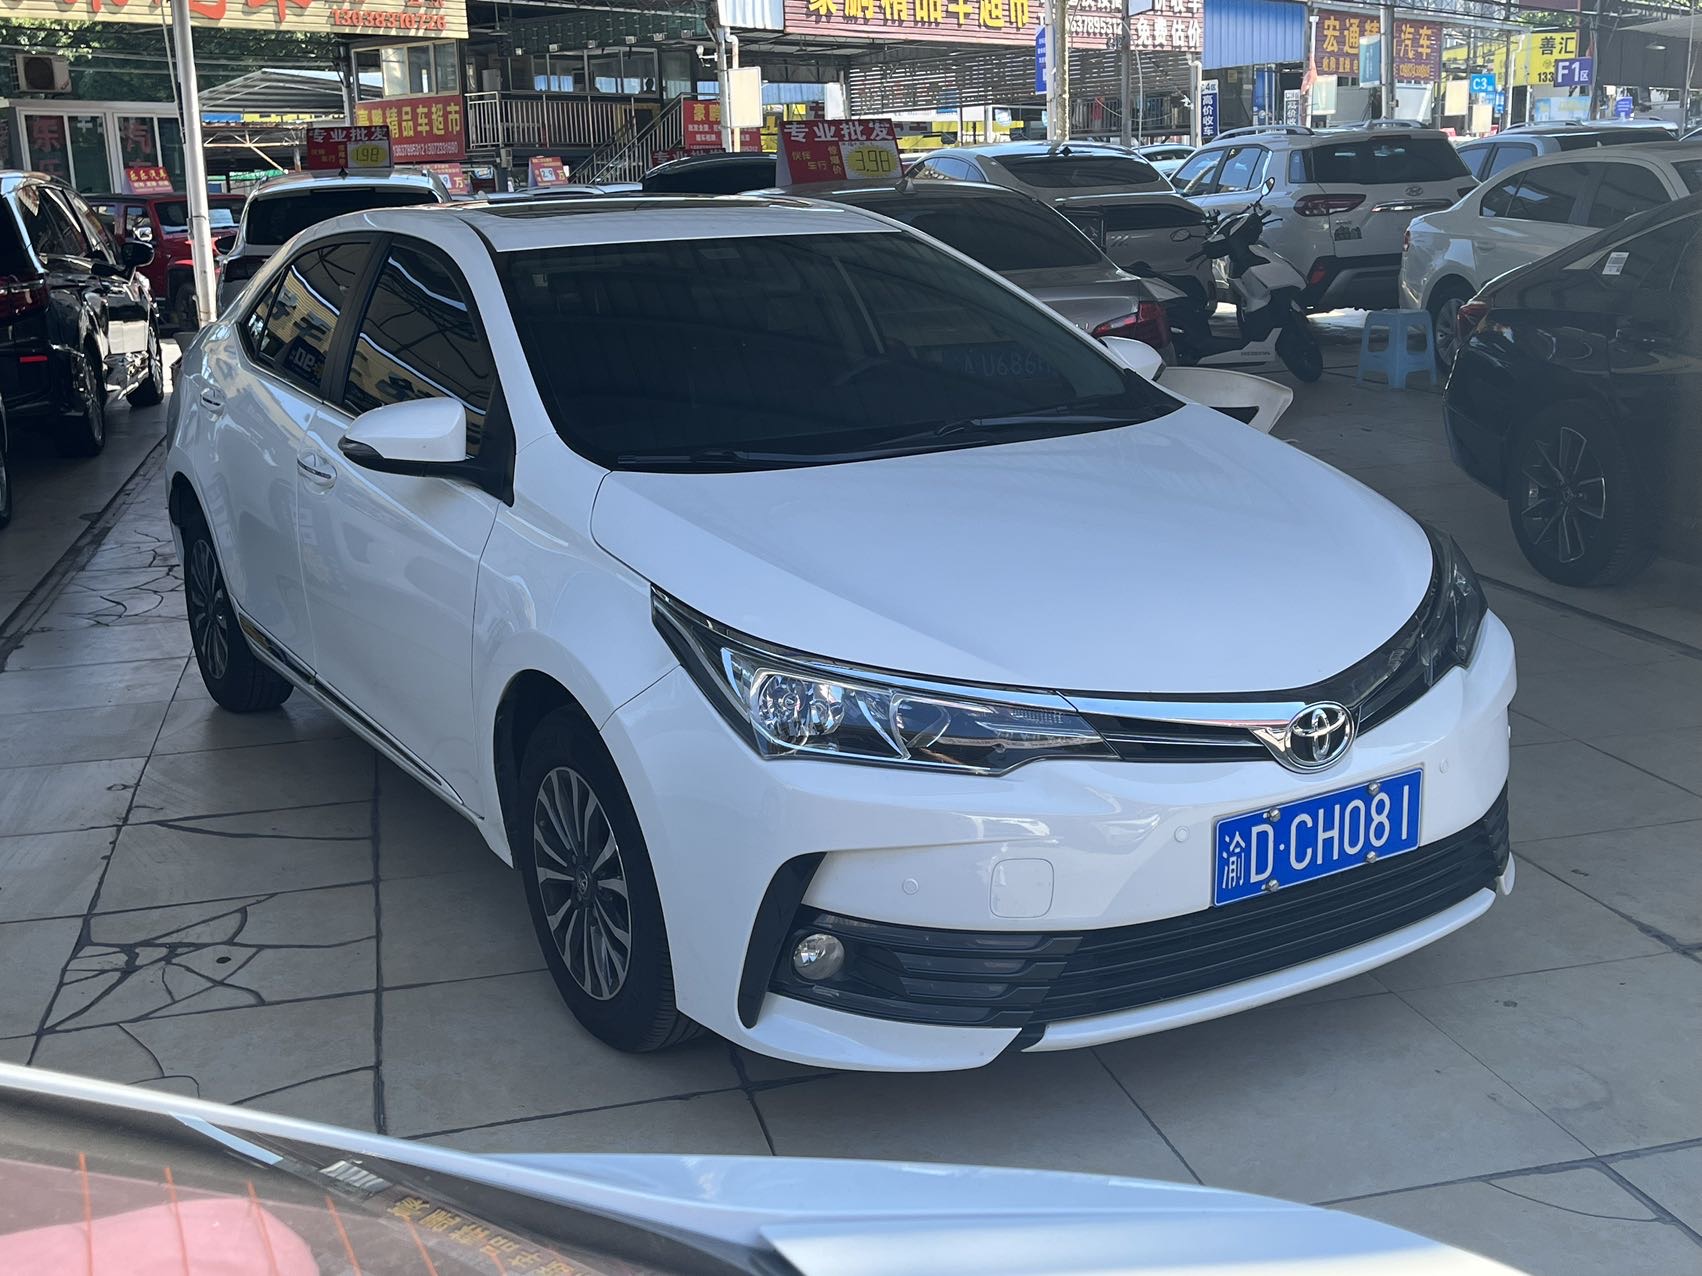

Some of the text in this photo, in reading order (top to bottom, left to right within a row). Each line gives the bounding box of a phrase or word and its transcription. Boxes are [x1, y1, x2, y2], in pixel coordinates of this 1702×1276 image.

[331, 9, 448, 30] 13038310726
[1137, 17, 1201, 47] 免费估价
[1557, 61, 1589, 83] F1区
[1202, 95, 1214, 136] 高价收车
[310, 127, 388, 143] 专业批发
[784, 121, 893, 143] 专业批发
[1222, 784, 1410, 890] 渝D·CH081
